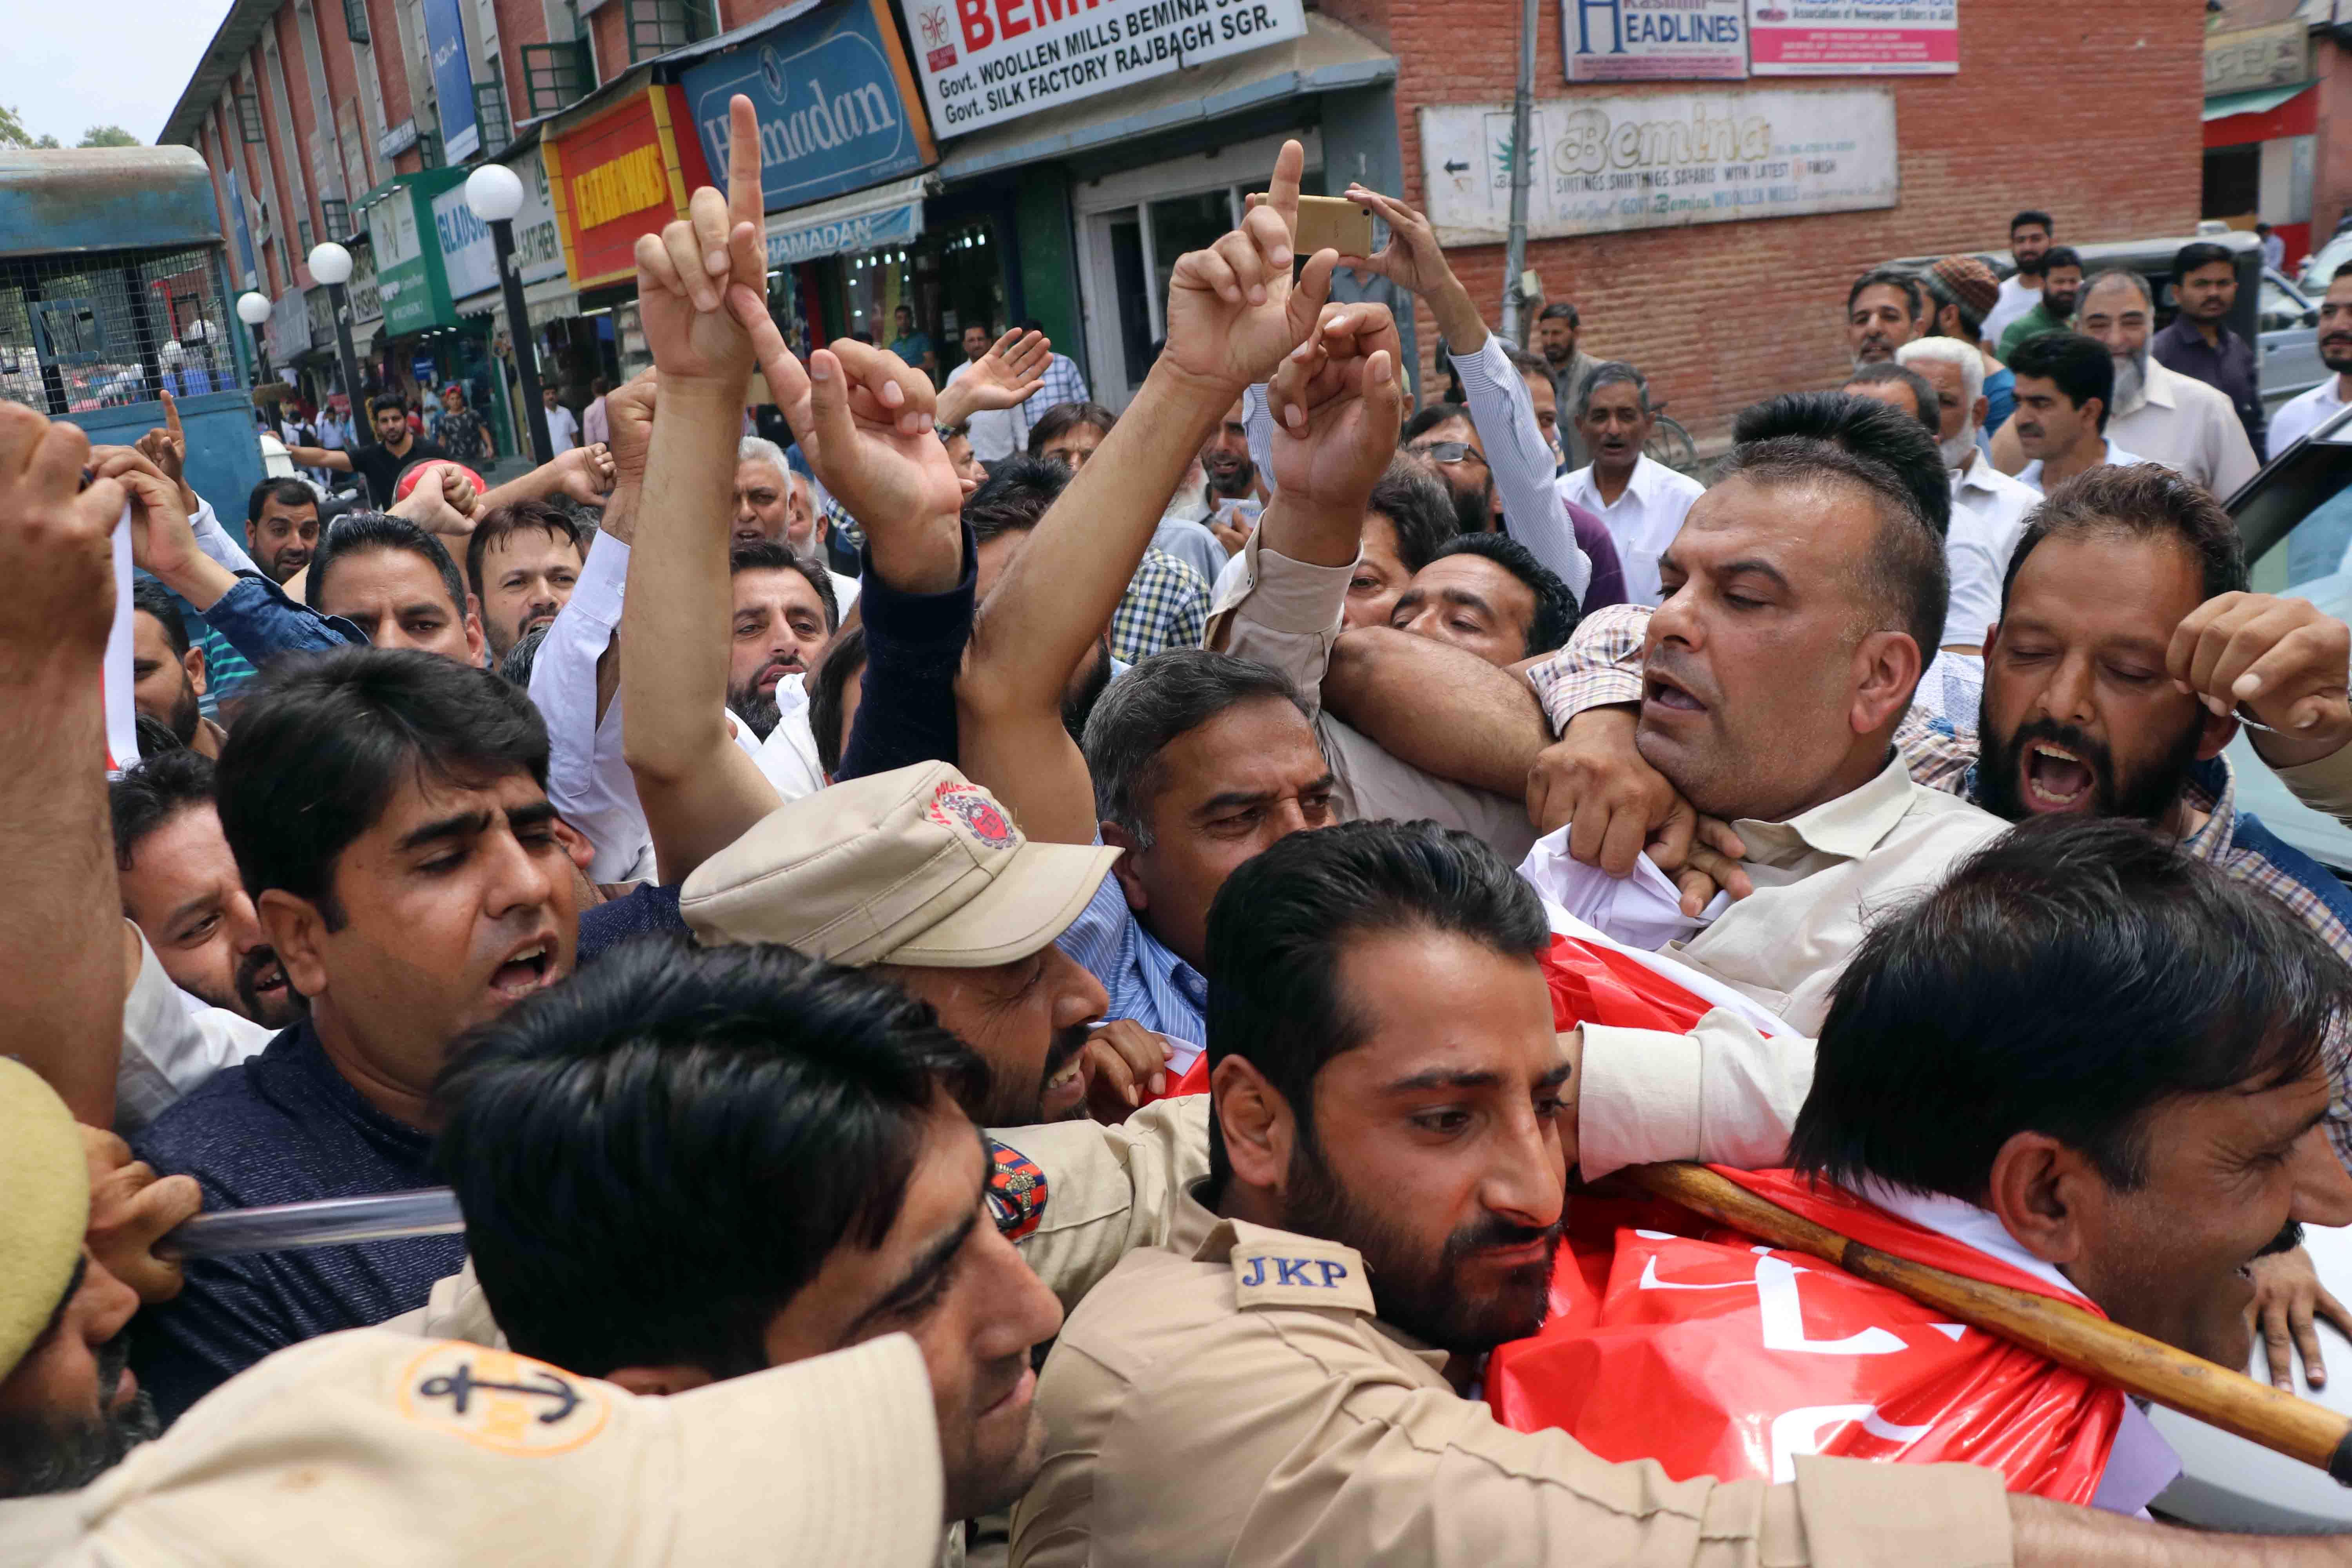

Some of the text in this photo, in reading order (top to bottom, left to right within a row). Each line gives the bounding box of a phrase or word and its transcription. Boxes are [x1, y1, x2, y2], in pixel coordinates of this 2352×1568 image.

[939, 71, 977, 98] Govt.
[979, 39, 1062, 85] WOOLLEN
[1065, 19, 1122, 57] MILLS
[1126, 0, 1209, 37] BEMINA
[946, 4, 1278, 123] Govt. SILK FACTORY RAJBAGH SGR.
[704, 78, 896, 179] Hmadan
[1554, 102, 1771, 175] Bemina
[1654, 194, 1710, 214] Bemina
[1712, 189, 1764, 207] WOOLLEN
[1769, 186, 1798, 202] MILLS
[1726, 163, 1750, 181] WITH
[1755, 162, 1788, 180] LATEST
[1807, 160, 1836, 174] FINISH
[1242, 1256, 1347, 1288] JKP
